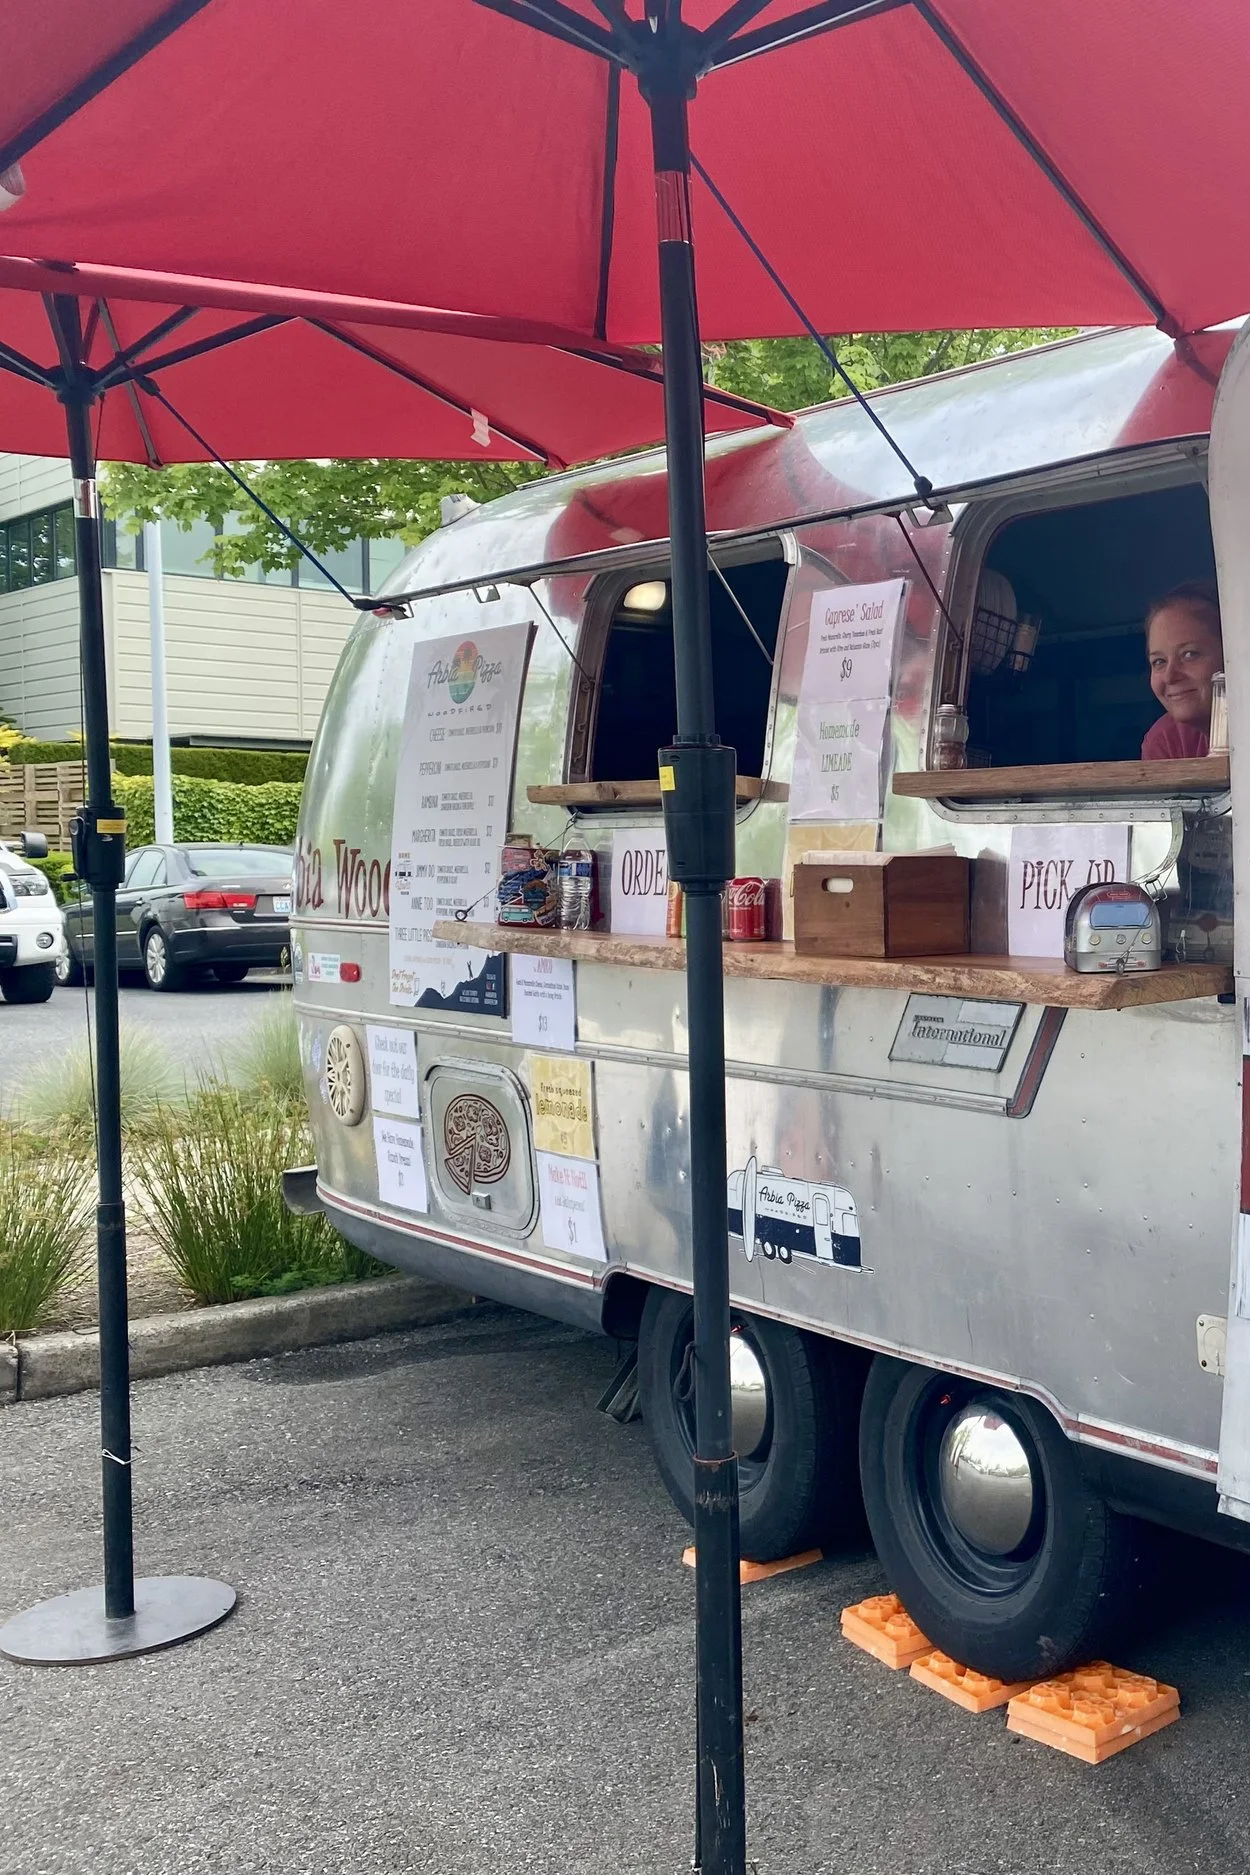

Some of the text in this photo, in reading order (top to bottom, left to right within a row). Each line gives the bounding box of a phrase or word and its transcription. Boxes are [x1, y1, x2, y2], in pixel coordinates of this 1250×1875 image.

[860, 600, 884, 621] Salad
[428, 655, 502, 689] Arbia Pizza
[840, 657, 853, 682] $9
[821, 753, 853, 773] LIMEADE
[621, 849, 669, 896] ORDE
[910, 1020, 1007, 1047] International
[540, 1082, 582, 1097] fresh squeezed
[535, 1093, 588, 1122] lemonade
[758, 1185, 811, 1213] Arbia Pizza
